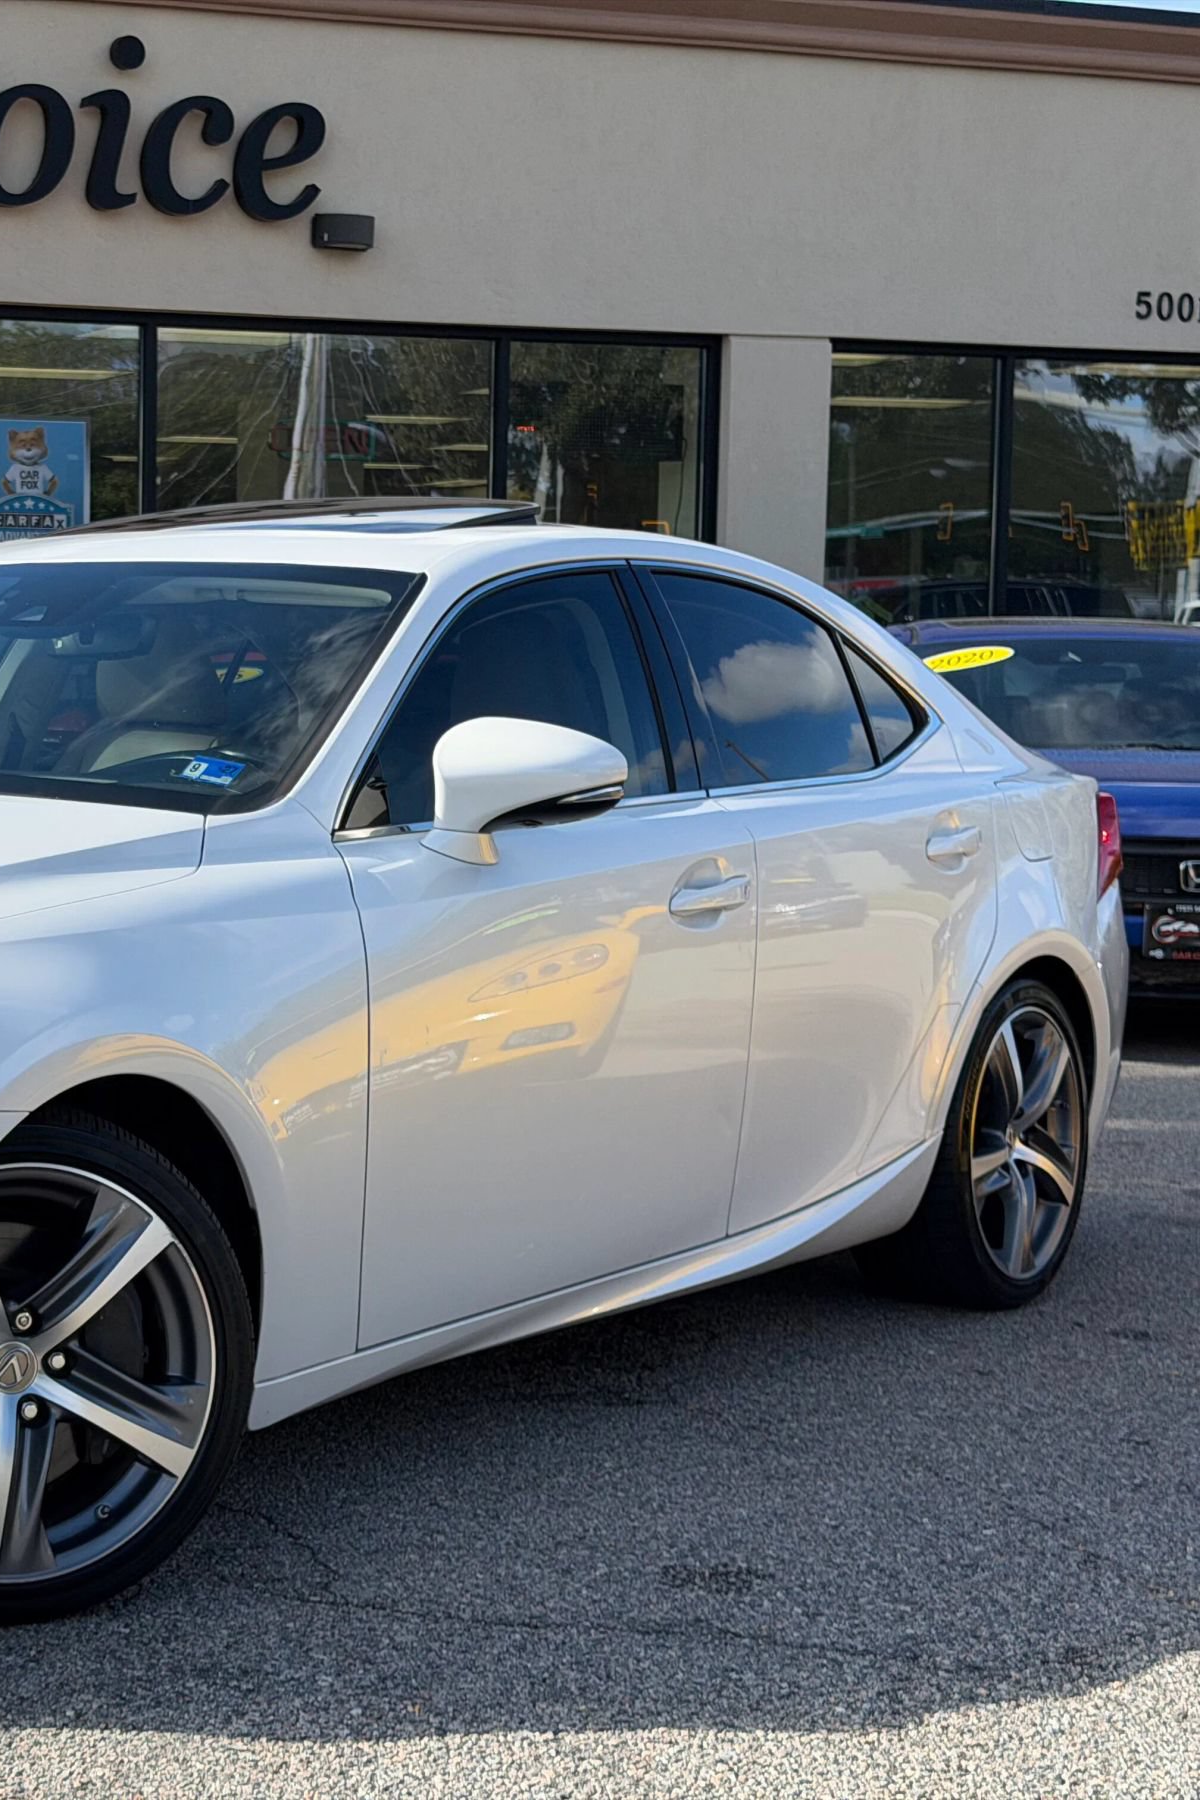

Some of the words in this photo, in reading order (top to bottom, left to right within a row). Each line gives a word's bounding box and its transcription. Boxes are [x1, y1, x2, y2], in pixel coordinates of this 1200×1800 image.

[1135, 291, 1200, 323] 500
[19, 470, 40, 480] CAR
[20, 480, 40, 490] FOX
[930, 650, 994, 670] 2020
[189, 763, 202, 773] 9
